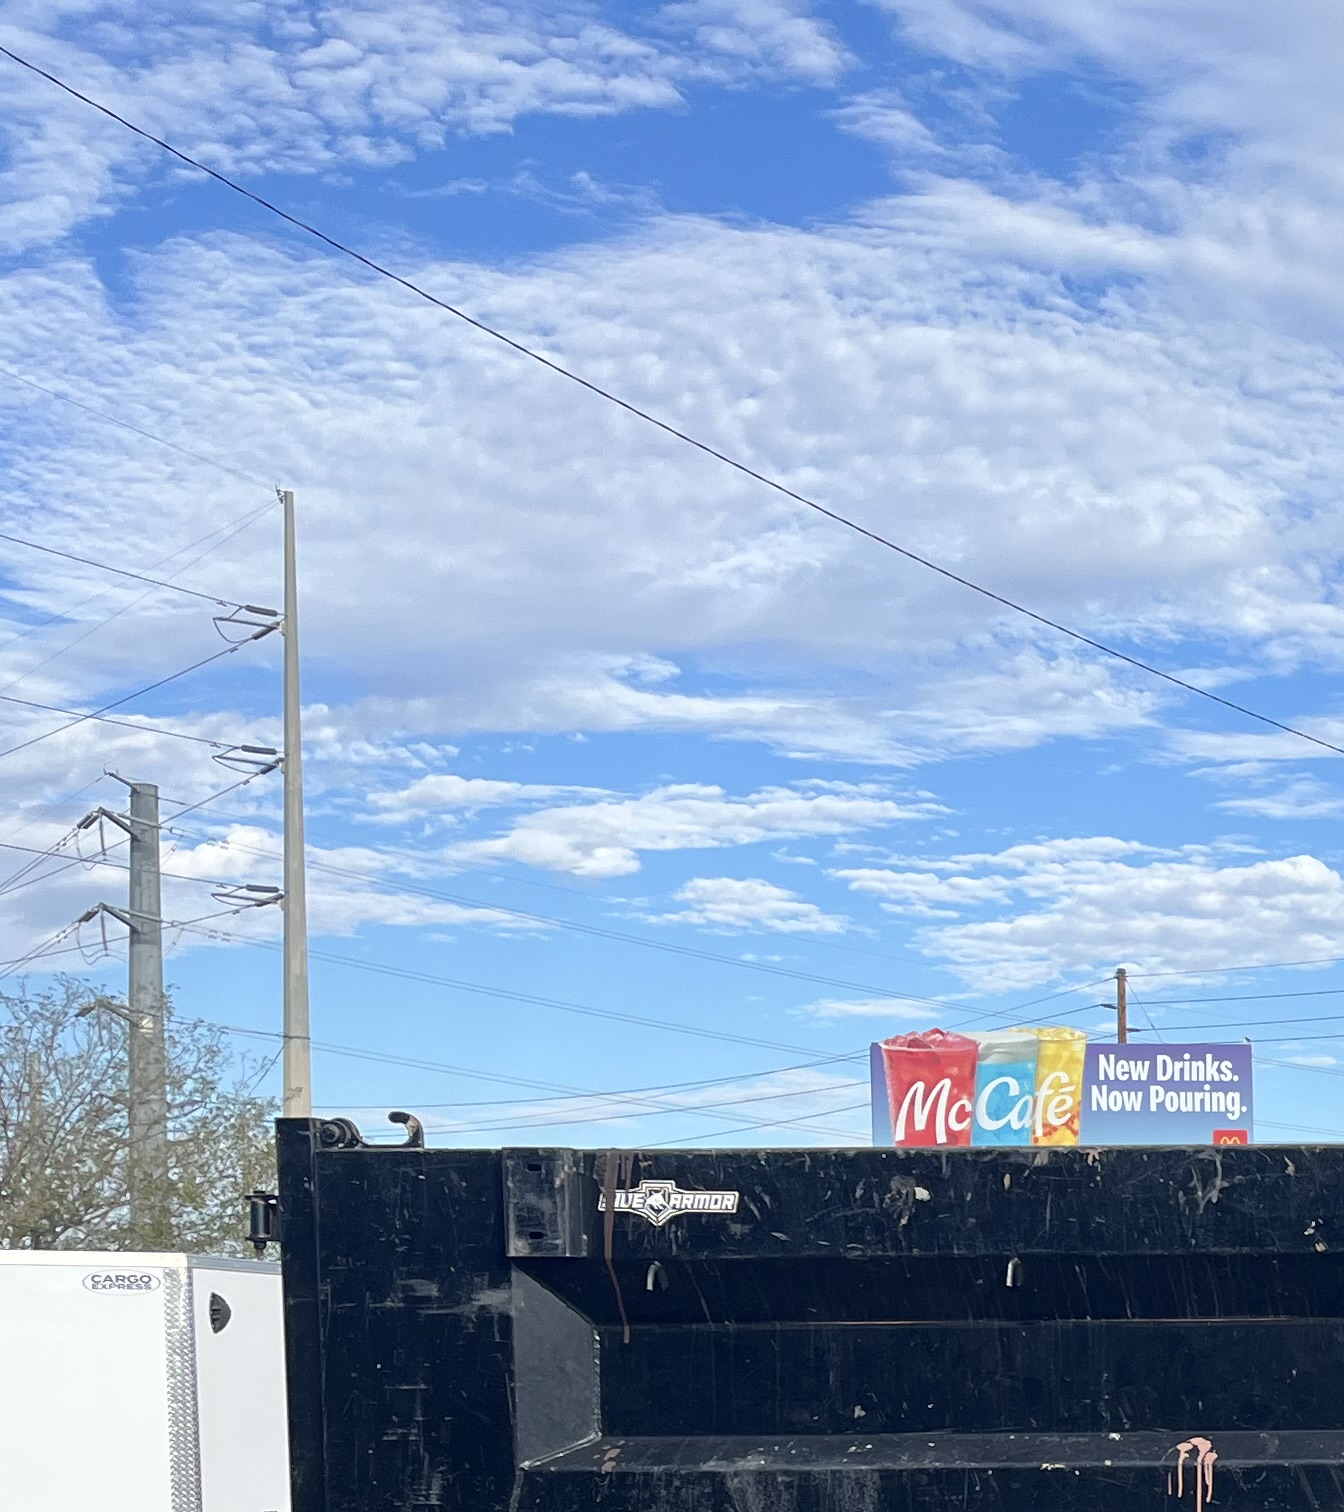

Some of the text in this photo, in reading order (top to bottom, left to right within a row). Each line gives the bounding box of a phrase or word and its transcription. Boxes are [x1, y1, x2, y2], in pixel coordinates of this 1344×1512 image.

[1098, 1053, 1239, 1081] New Drinks.
[895, 1071, 1076, 1144] McCafé
[1091, 1084, 1247, 1121] Now Pouring.
[669, 1194, 735, 1209] ARMOR
[91, 1274, 152, 1284] CARGO
